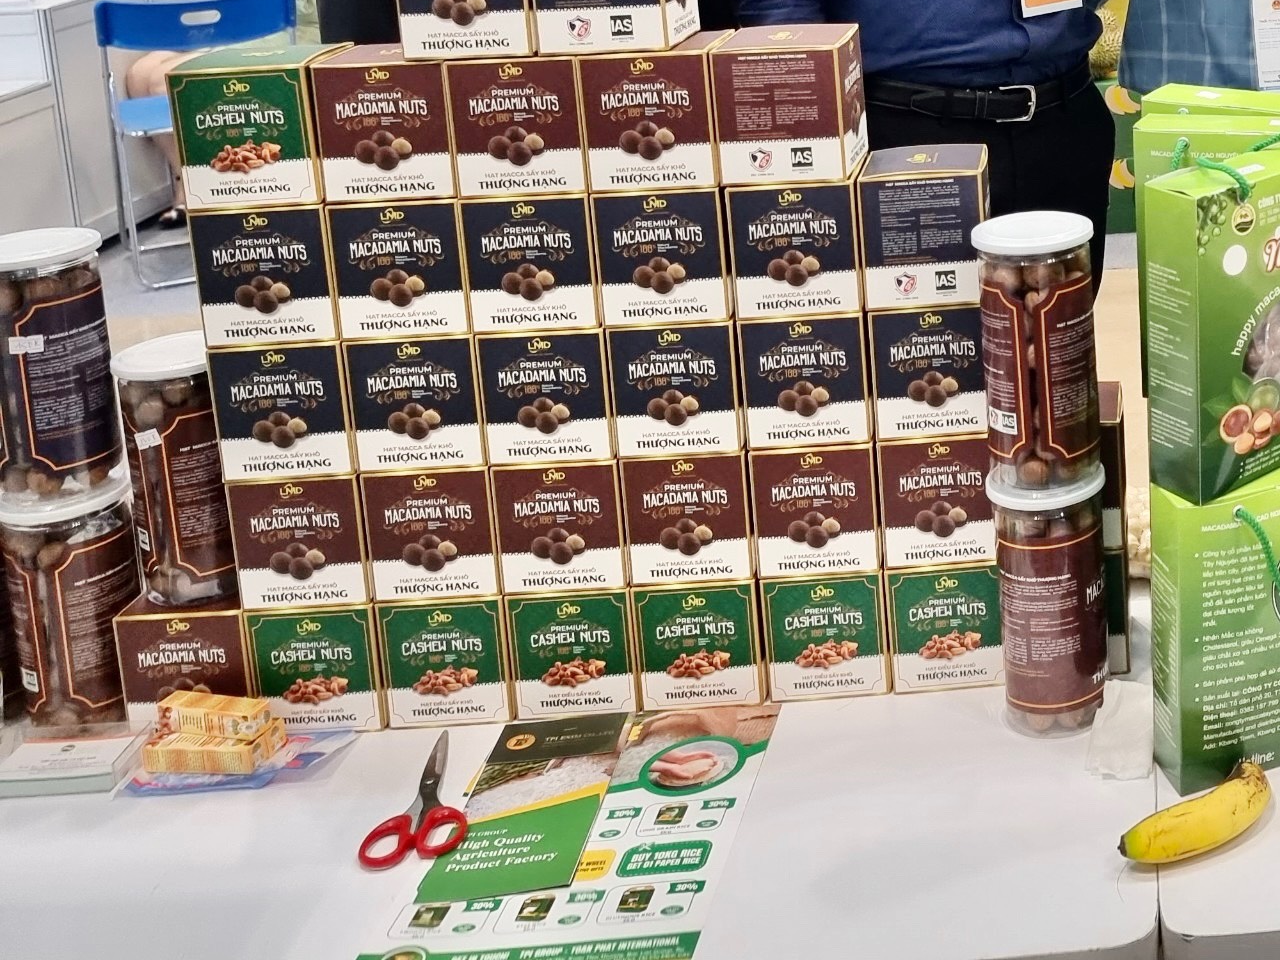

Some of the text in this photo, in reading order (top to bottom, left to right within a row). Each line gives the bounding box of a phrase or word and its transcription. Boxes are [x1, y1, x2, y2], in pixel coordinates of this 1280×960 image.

[610, 17, 633, 34] IAS
[421, 36, 510, 51] THƯỢNG HẠNG
[622, 82, 665, 93] PREMIUM
[601, 90, 690, 110] MACADAMIA NUTS
[217, 103, 259, 112] PREMIUM
[196, 110, 285, 130] CASHEW NUTS
[609, 171, 696, 185] THƯỢNG HẠNG
[210, 183, 291, 197] THƯỢNG HẠNG
[1230, 314, 1256, 357] happy
[781, 344, 823, 353] PREMIUM
[759, 351, 846, 372] MACADAMIA NUTS
[766, 426, 850, 441] THƯỢNG HẠNG
[406, 498, 447, 507] PREMIUM
[385, 505, 472, 525] MACADAMIA NUTS
[393, 581, 479, 595] THƯỢNG HẠNG
[804, 606, 842, 615] PREMIUM
[785, 612, 863, 631] CASHEW NUTS
[793, 677, 865, 690] THƯỢNG HẠNG
[494, 833, 544, 847] Quality
[450, 845, 530, 862] Agriculture
[680, 848, 703, 858] RICE
[445, 851, 558, 873] Product Factory
[675, 883, 699, 891] 30%
